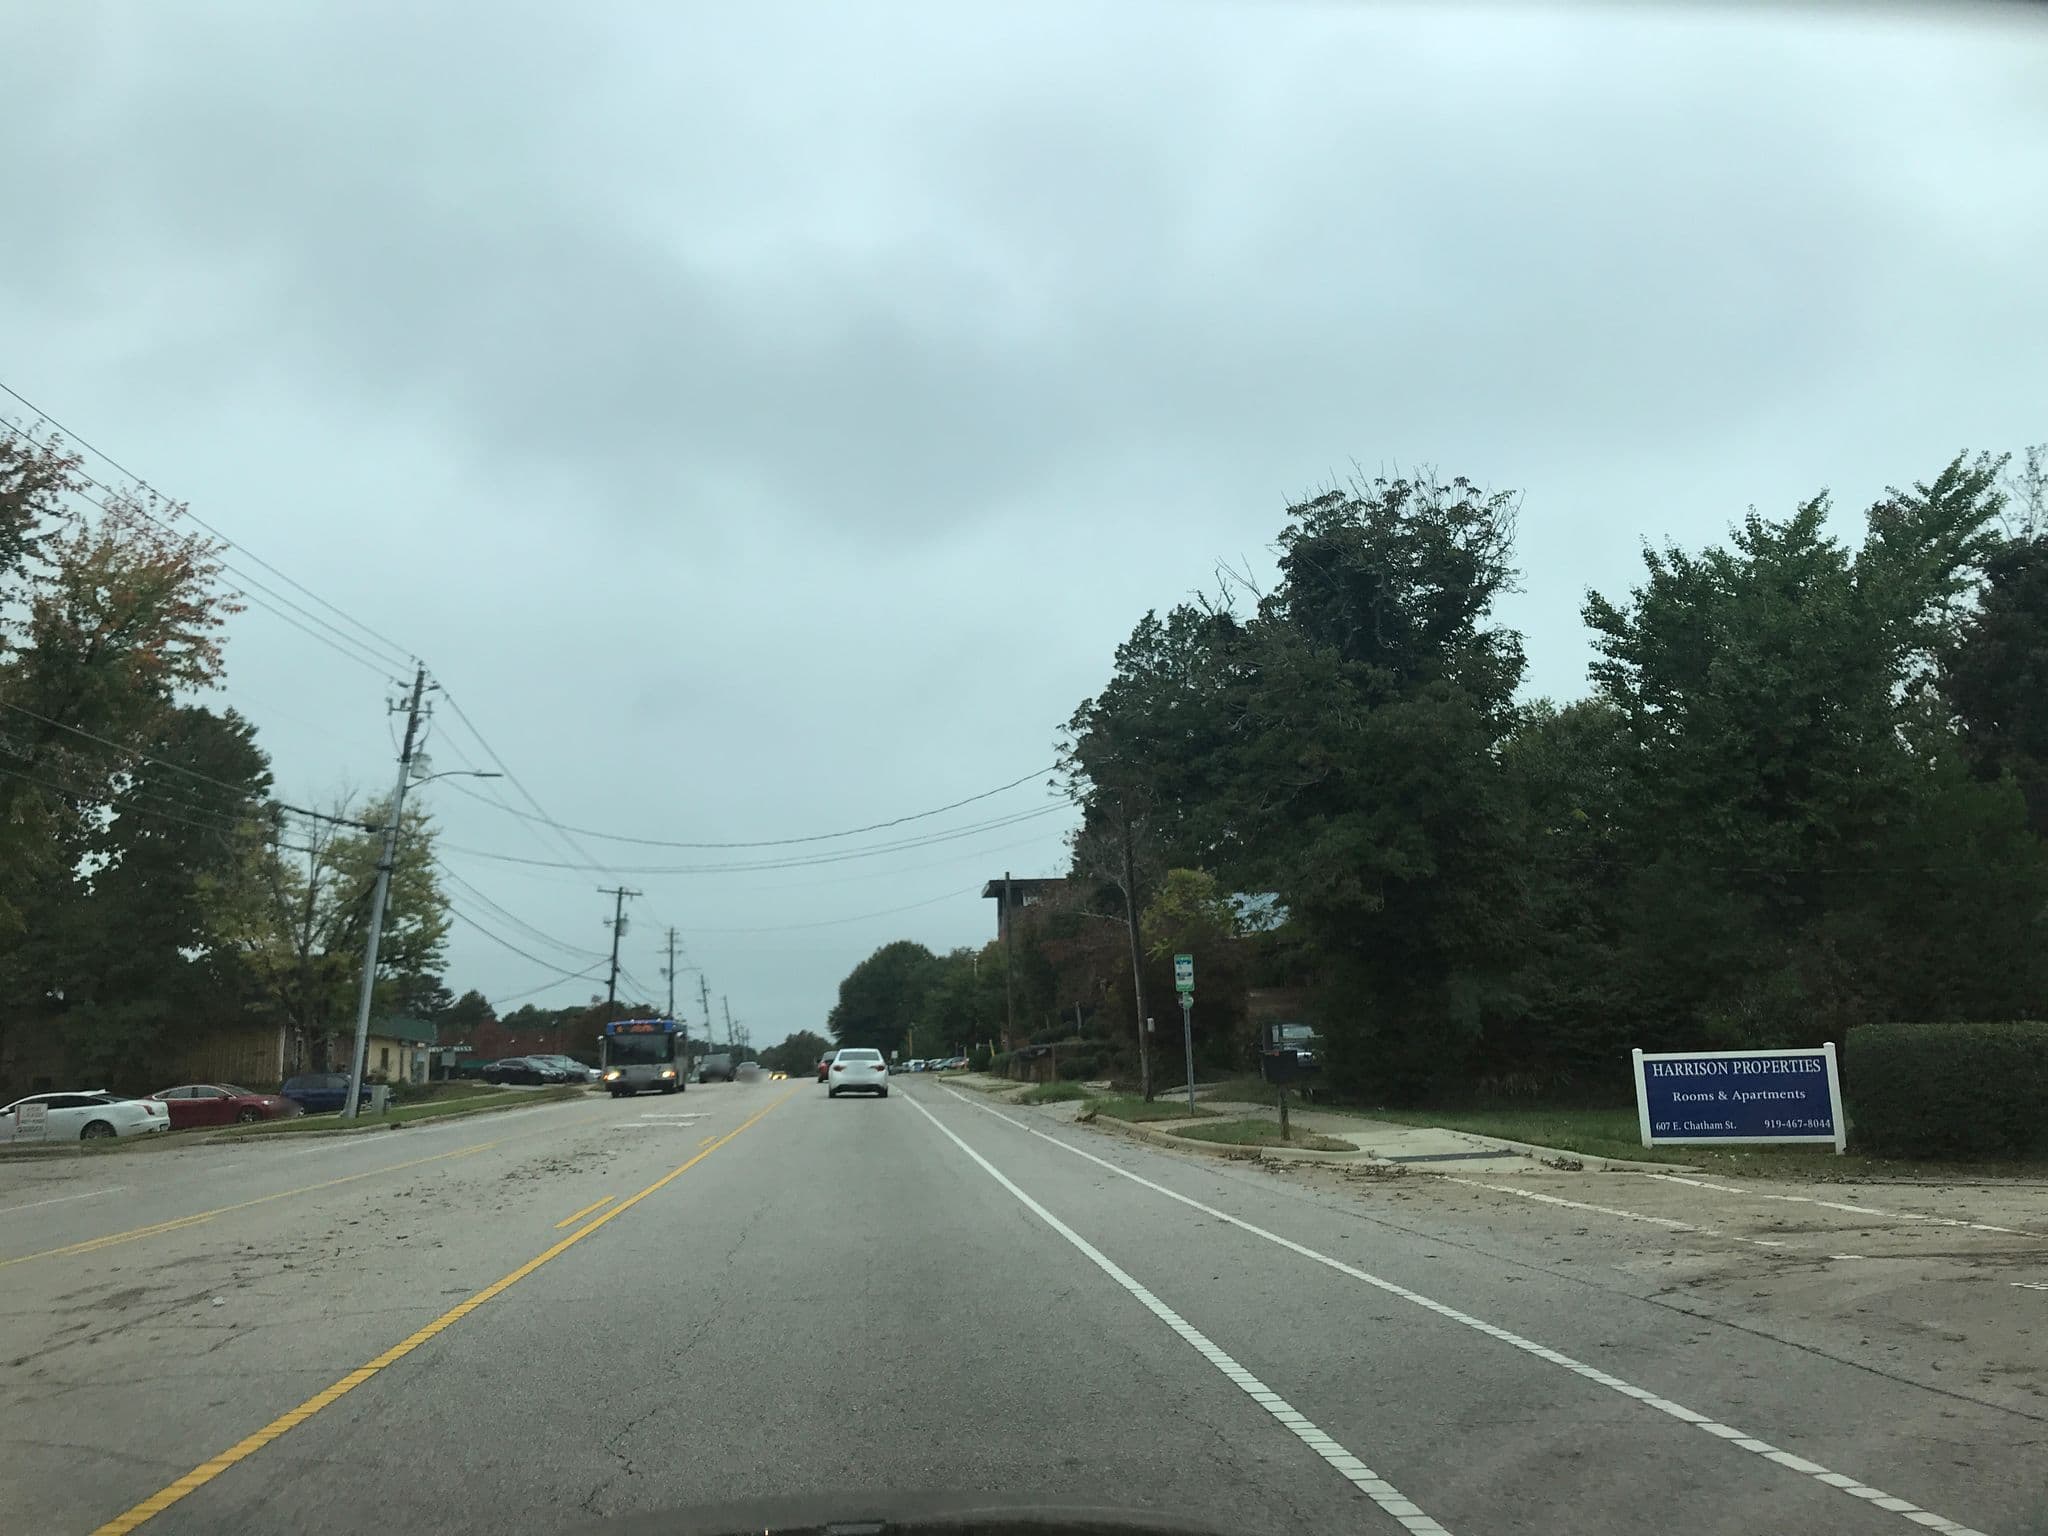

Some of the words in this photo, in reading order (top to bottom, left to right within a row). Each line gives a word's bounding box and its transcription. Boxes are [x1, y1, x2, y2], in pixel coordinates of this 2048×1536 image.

[1652, 1061, 1729, 1077] HARRISON
[1733, 1059, 1821, 1075] PROPERTIES
[1673, 1091, 1714, 1102] Rooms
[1718, 1091, 1728, 1101] &
[1732, 1089, 1806, 1103] Apartments
[1656, 1121, 1671, 1131] 607
[1673, 1121, 1682, 1131] E.
[1684, 1120, 1723, 1131] Chatham
[1725, 1120, 1737, 1130] St.
[1764, 1118, 1831, 1129] 919-467-8044
